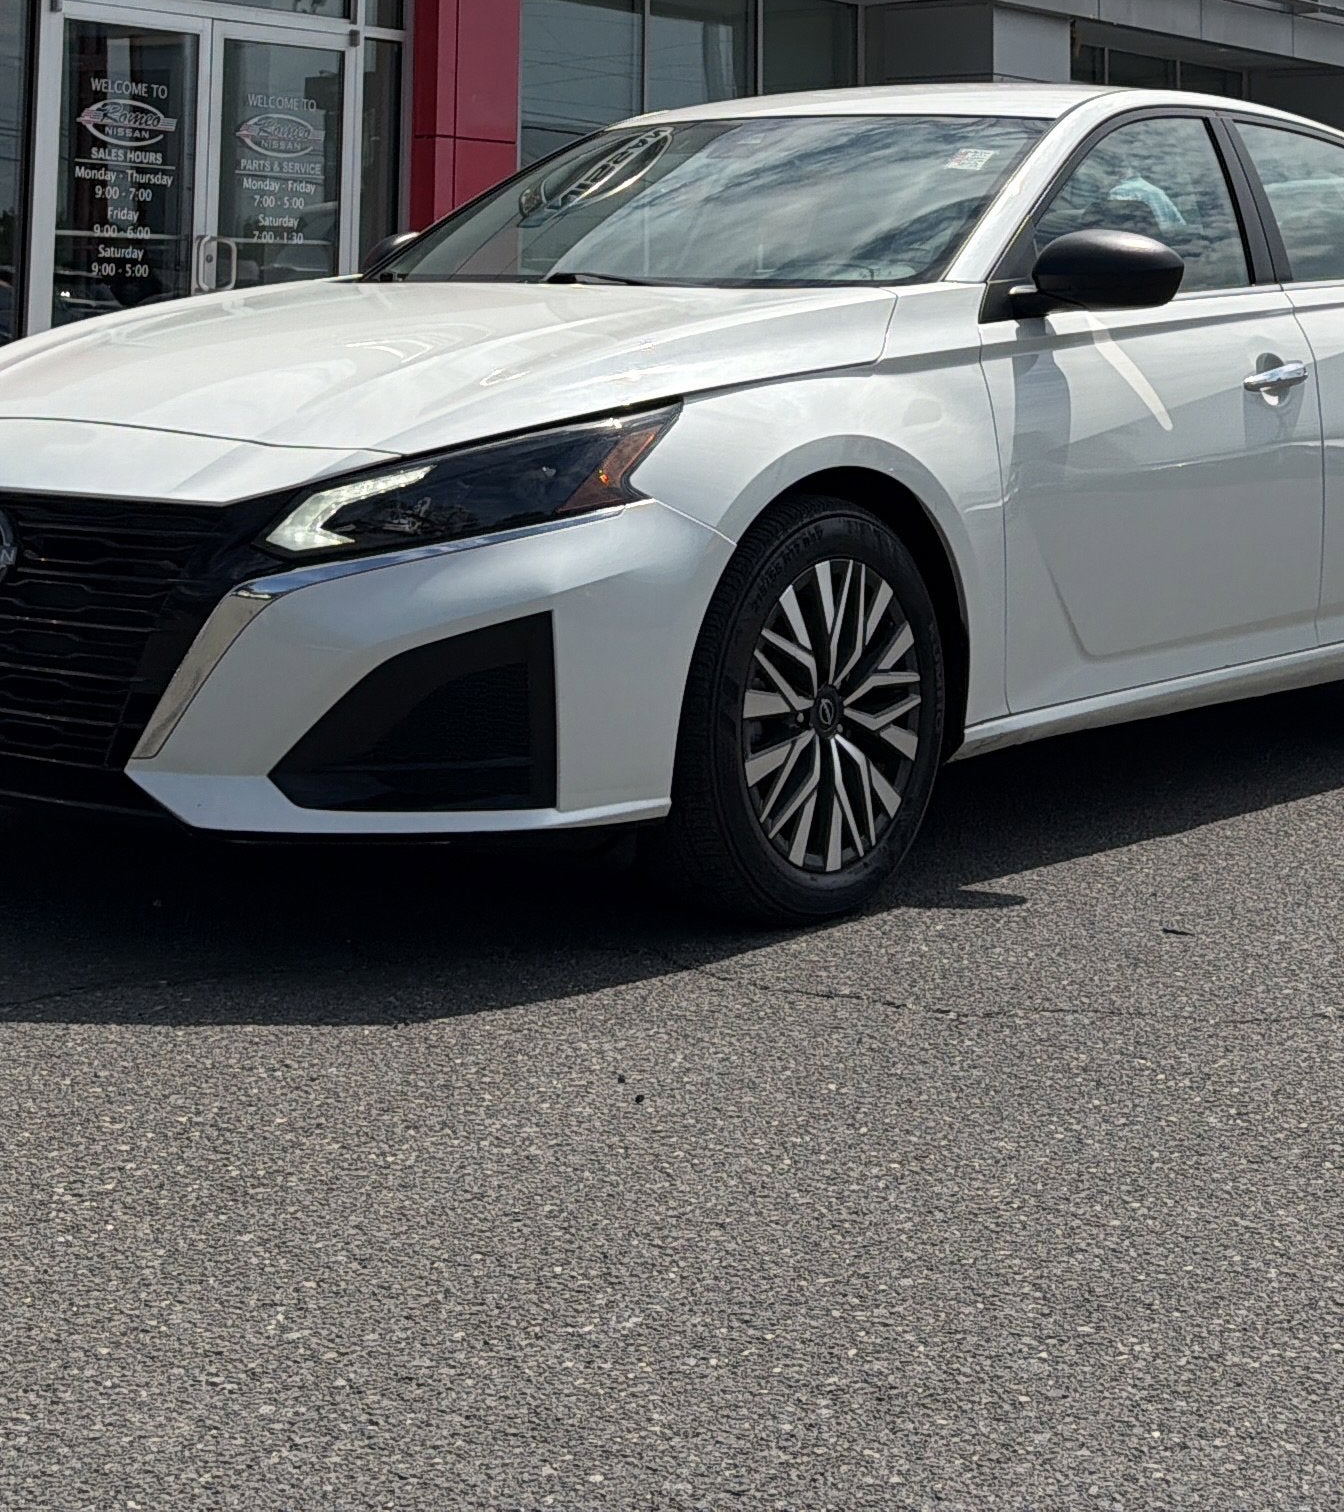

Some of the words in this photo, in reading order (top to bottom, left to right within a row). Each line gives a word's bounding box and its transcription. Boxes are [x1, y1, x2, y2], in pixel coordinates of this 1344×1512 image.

[90, 77, 148, 97] WELCOME
[151, 84, 168, 99] TO
[247, 93, 299, 110] WELCOME
[301, 98, 317, 112] TO
[98, 102, 161, 127] Romeo
[104, 127, 150, 139] NISSAN
[260, 139, 301, 150] NISSAN
[91, 147, 125, 161] SALES
[126, 149, 163, 164] HOURS
[240, 159, 271, 171] PARTS
[273, 161, 280, 172] &
[282, 162, 322, 175] SERVICE
[74, 165, 117, 183] Monday
[126, 169, 174, 187] Thursday
[95, 185, 120, 199] 9:00
[128, 188, 153, 201] 7:00
[242, 177, 280, 193] Monday
[287, 180, 316, 195] Friday
[253, 195, 275, 207] 7:00
[283, 196, 304, 209] 5:00
[107, 207, 139, 223] Friday
[258, 213, 300, 229] Saturday
[93, 224, 117, 237] 9:00
[126, 225, 151, 239] 6:00
[252, 231, 275, 243] 7:00
[283, 232, 304, 244] 1:30
[97, 244, 144, 262] Saturday
[91, 262, 116, 276] 9:00
[125, 264, 149, 277] 5:00
